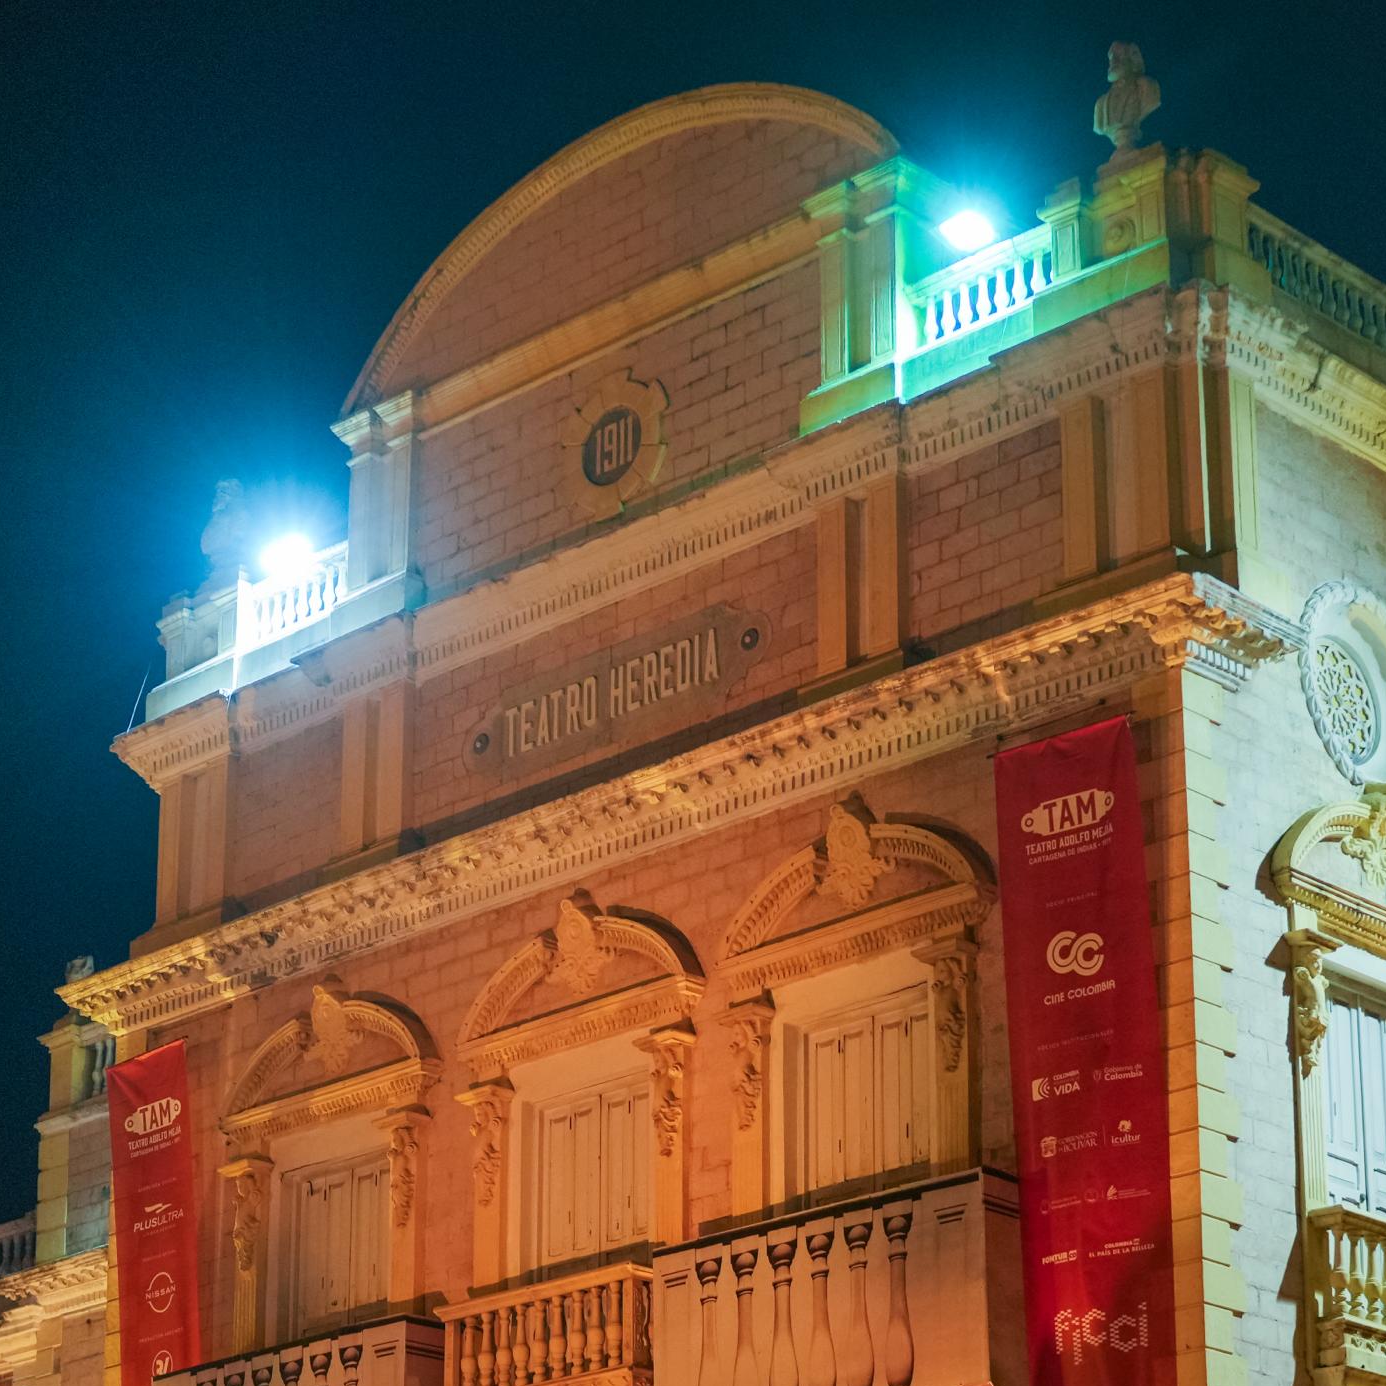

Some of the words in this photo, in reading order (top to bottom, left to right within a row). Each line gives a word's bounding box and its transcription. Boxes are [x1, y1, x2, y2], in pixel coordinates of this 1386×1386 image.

[595, 415, 634, 476] 1911
[505, 675, 599, 757] TEATRO
[609, 628, 719, 718] HEREDIA
[1042, 791, 1098, 832] TAM
[1025, 839, 1057, 856] TEATRO
[1059, 831, 1090, 848] ADOLFO
[1028, 849, 1067, 865] CARTAGENA
[1043, 991, 1065, 1006] CINE
[1067, 979, 1116, 1000] COLOMBIA
[1053, 1081, 1080, 1096] VIDA
[1104, 1070, 1143, 1081] Colombia
[139, 1099, 172, 1132] TAM
[128, 1138, 148, 1150] TEATRO
[149, 1131, 168, 1144] ADOLFO
[145, 1284, 176, 1301] NISSAN
[1054, 1302, 1148, 1366] ficci
